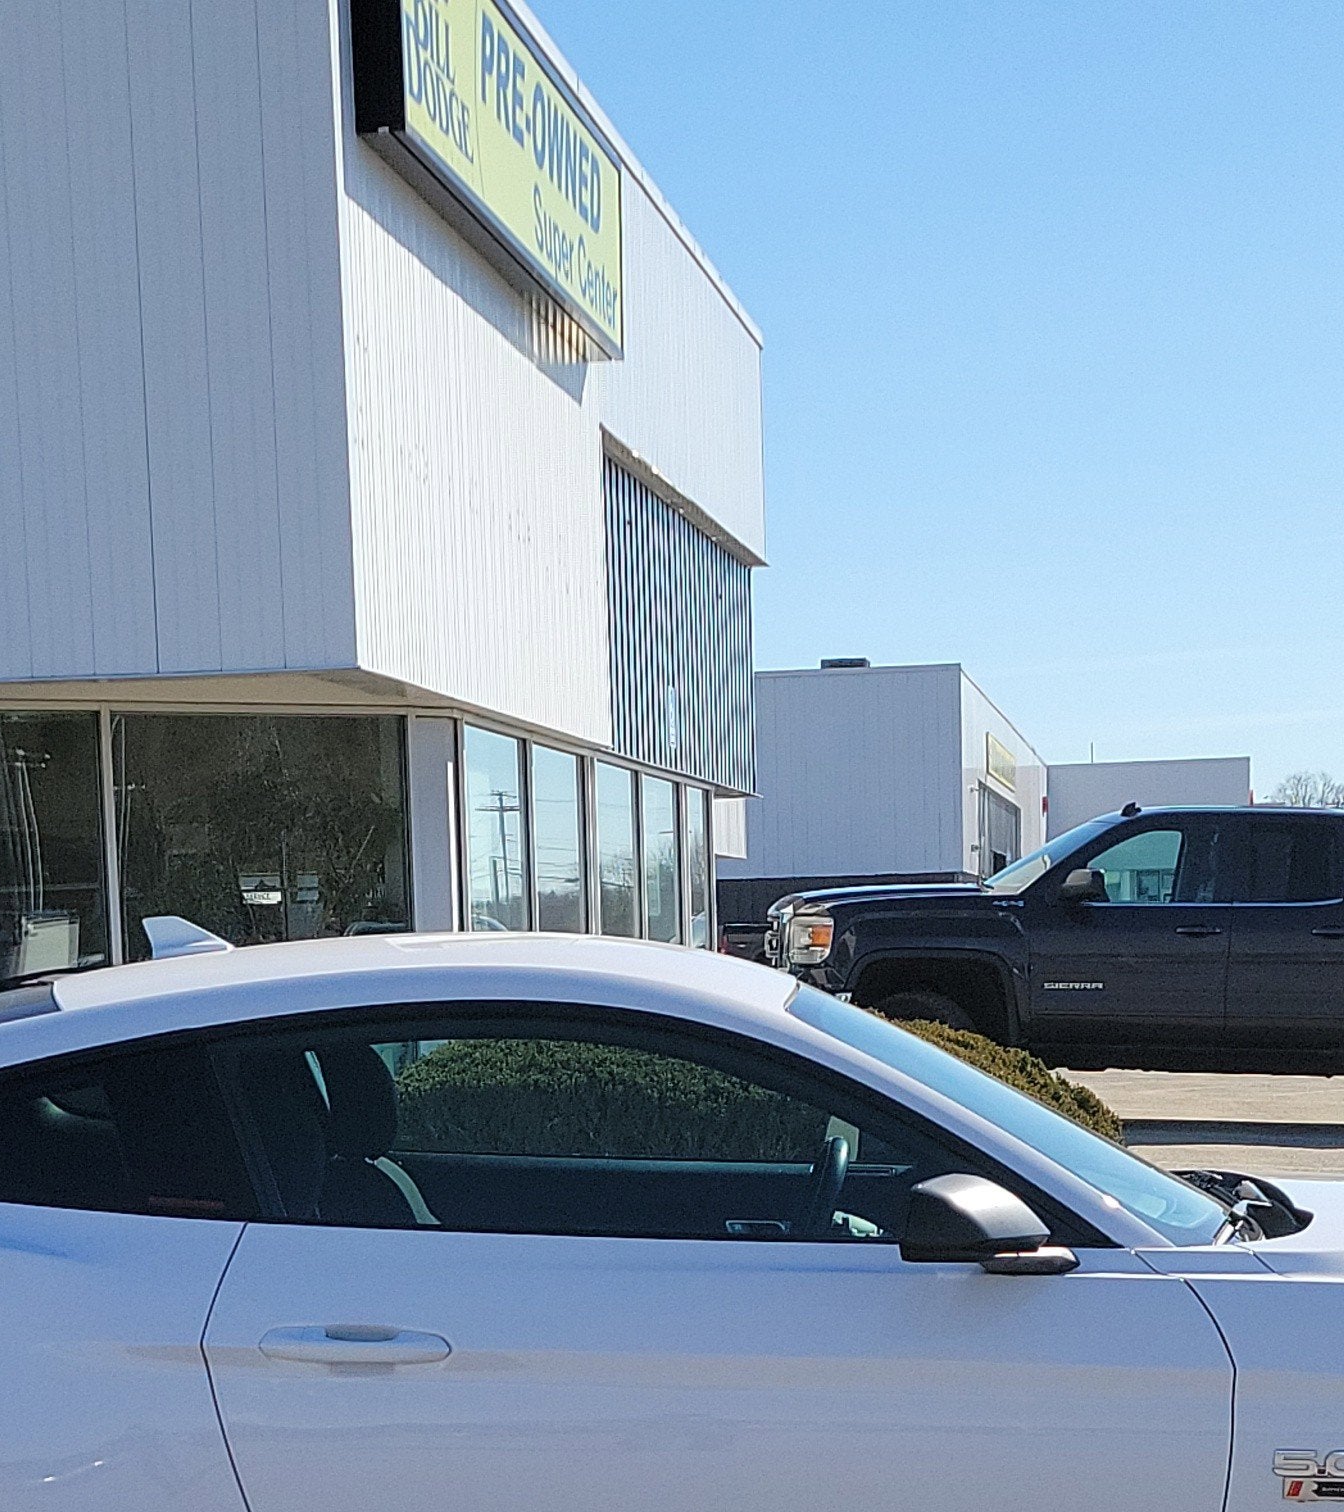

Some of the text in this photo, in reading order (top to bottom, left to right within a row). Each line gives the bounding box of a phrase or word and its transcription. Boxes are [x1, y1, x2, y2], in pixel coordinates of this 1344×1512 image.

[404, 10, 474, 164] DODGE
[481, 8, 602, 235] PRE-OWNED
[533, 182, 618, 331] Super Center
[1043, 982, 1104, 990] SIERRA
